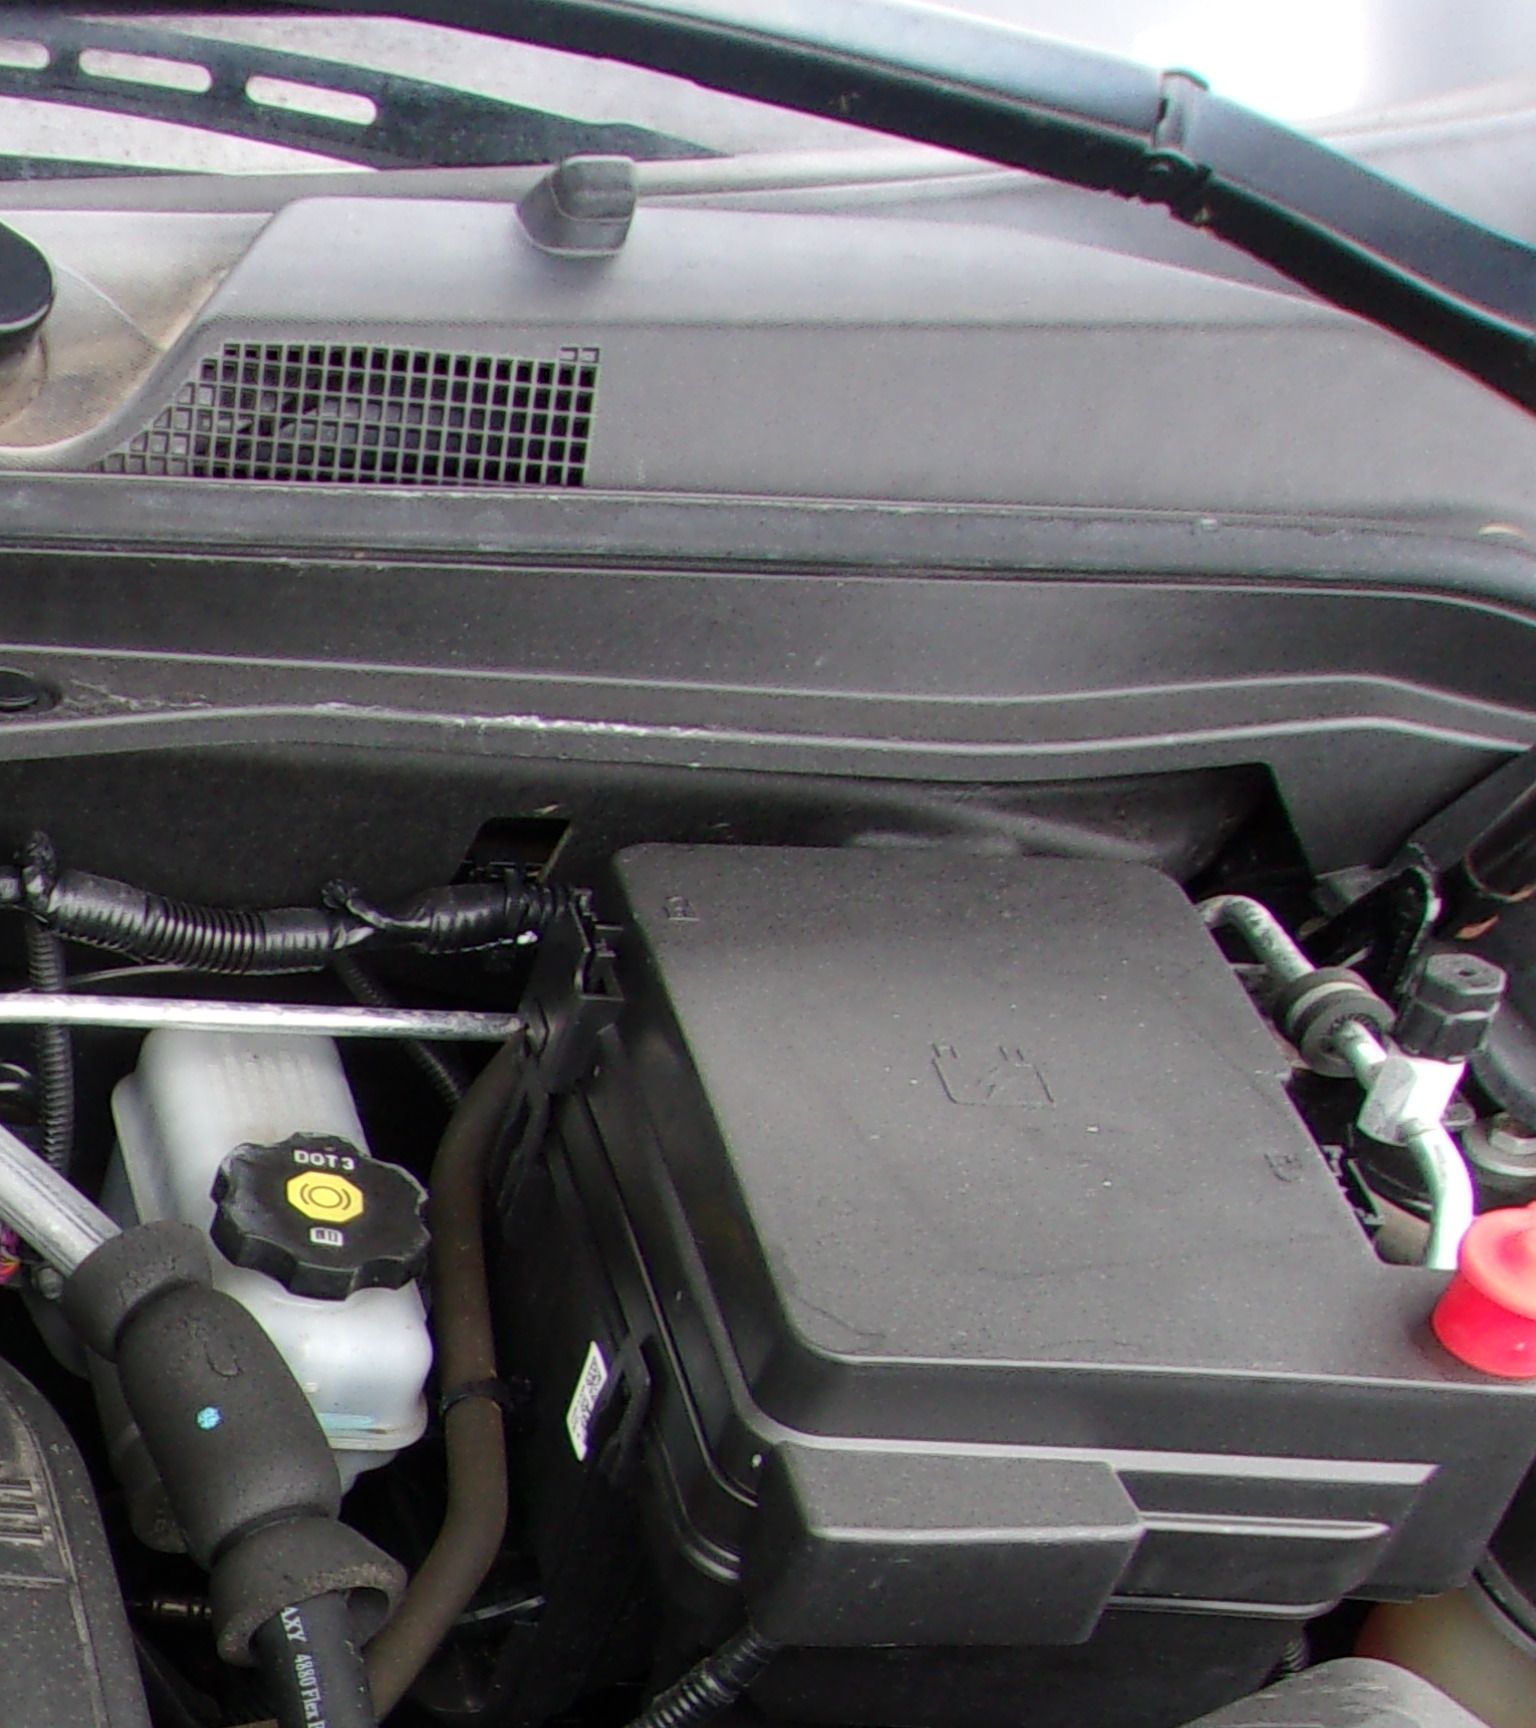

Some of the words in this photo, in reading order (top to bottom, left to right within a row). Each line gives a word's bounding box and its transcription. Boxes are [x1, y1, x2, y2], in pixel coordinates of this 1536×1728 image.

[293, 1149, 338, 1169] DOT
[341, 1156, 356, 1171] 3
[294, 1653, 314, 1688] 4880
[301, 1687, 321, 1721] Flex
